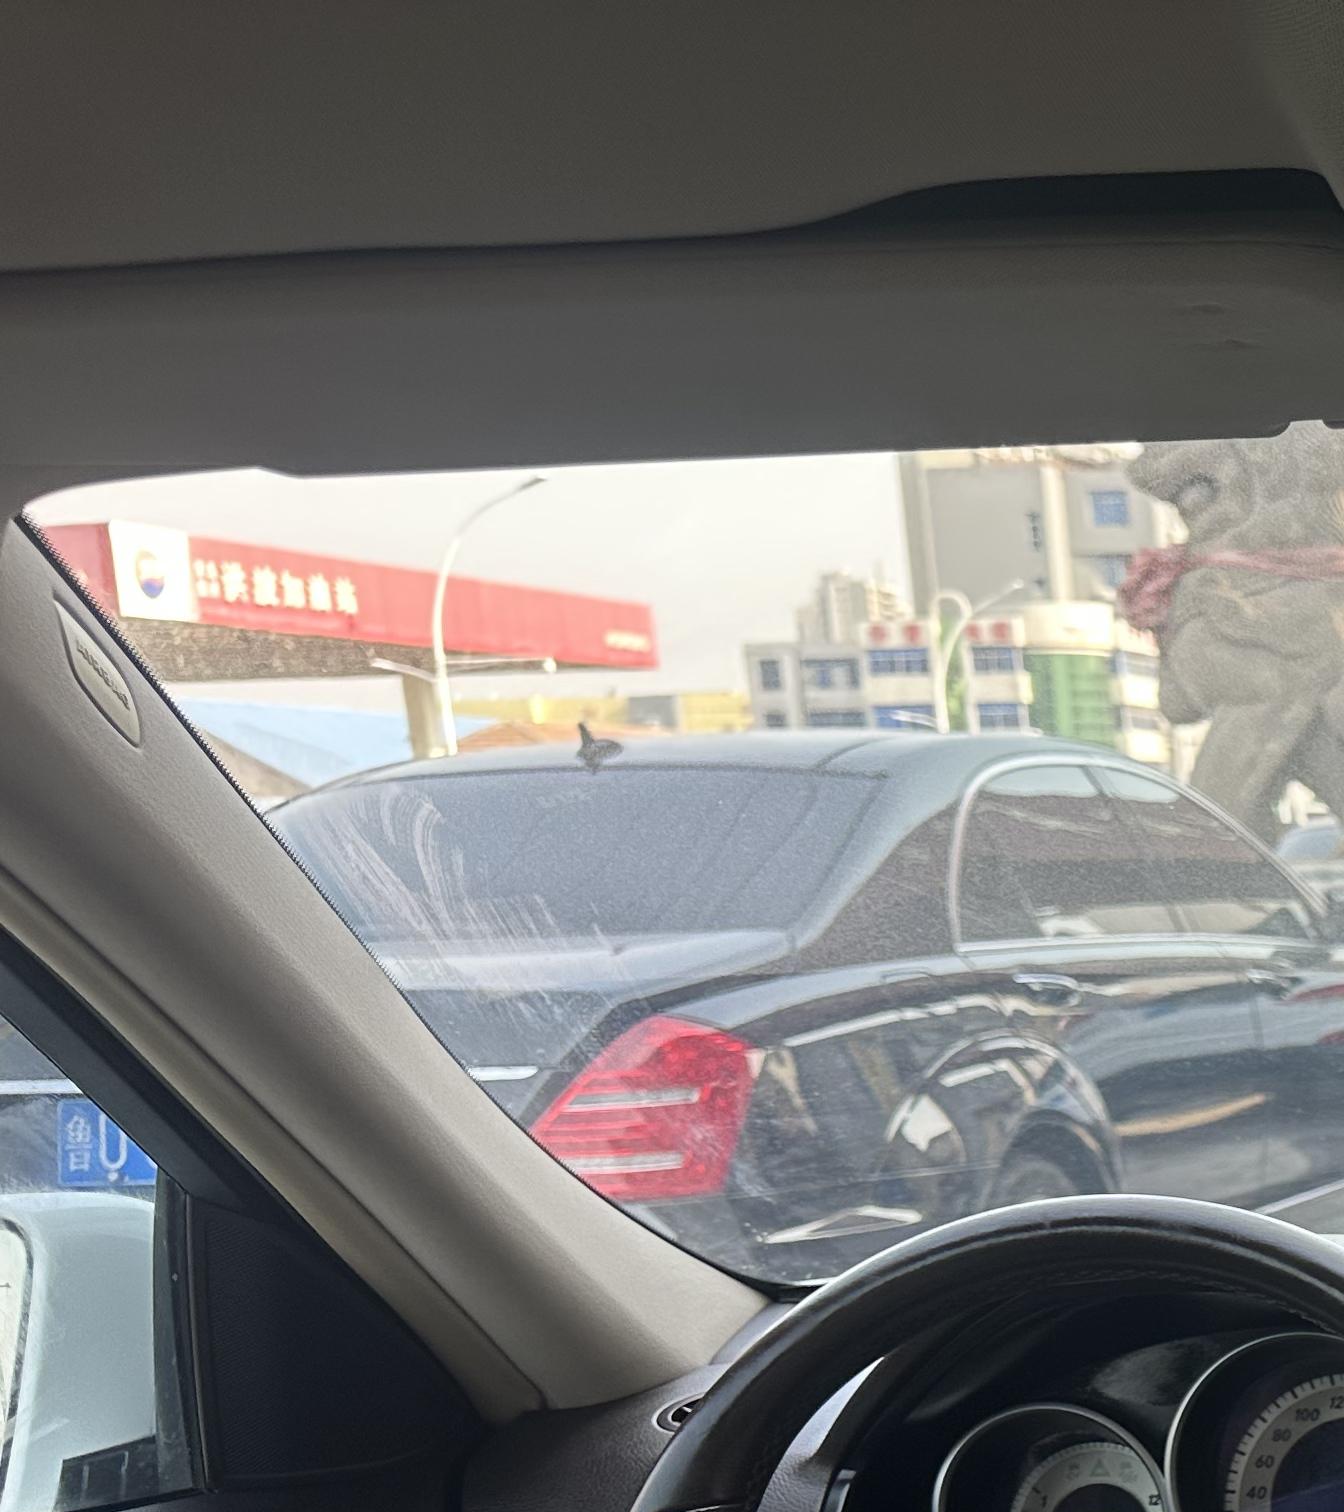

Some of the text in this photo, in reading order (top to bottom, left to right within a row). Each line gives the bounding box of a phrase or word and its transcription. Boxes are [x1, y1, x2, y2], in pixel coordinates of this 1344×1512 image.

[1295, 1408, 1321, 1422] 100
[1271, 1428, 1291, 1443] 80
[1255, 1455, 1274, 1469] 60
[1247, 1486, 1267, 1499] 40
